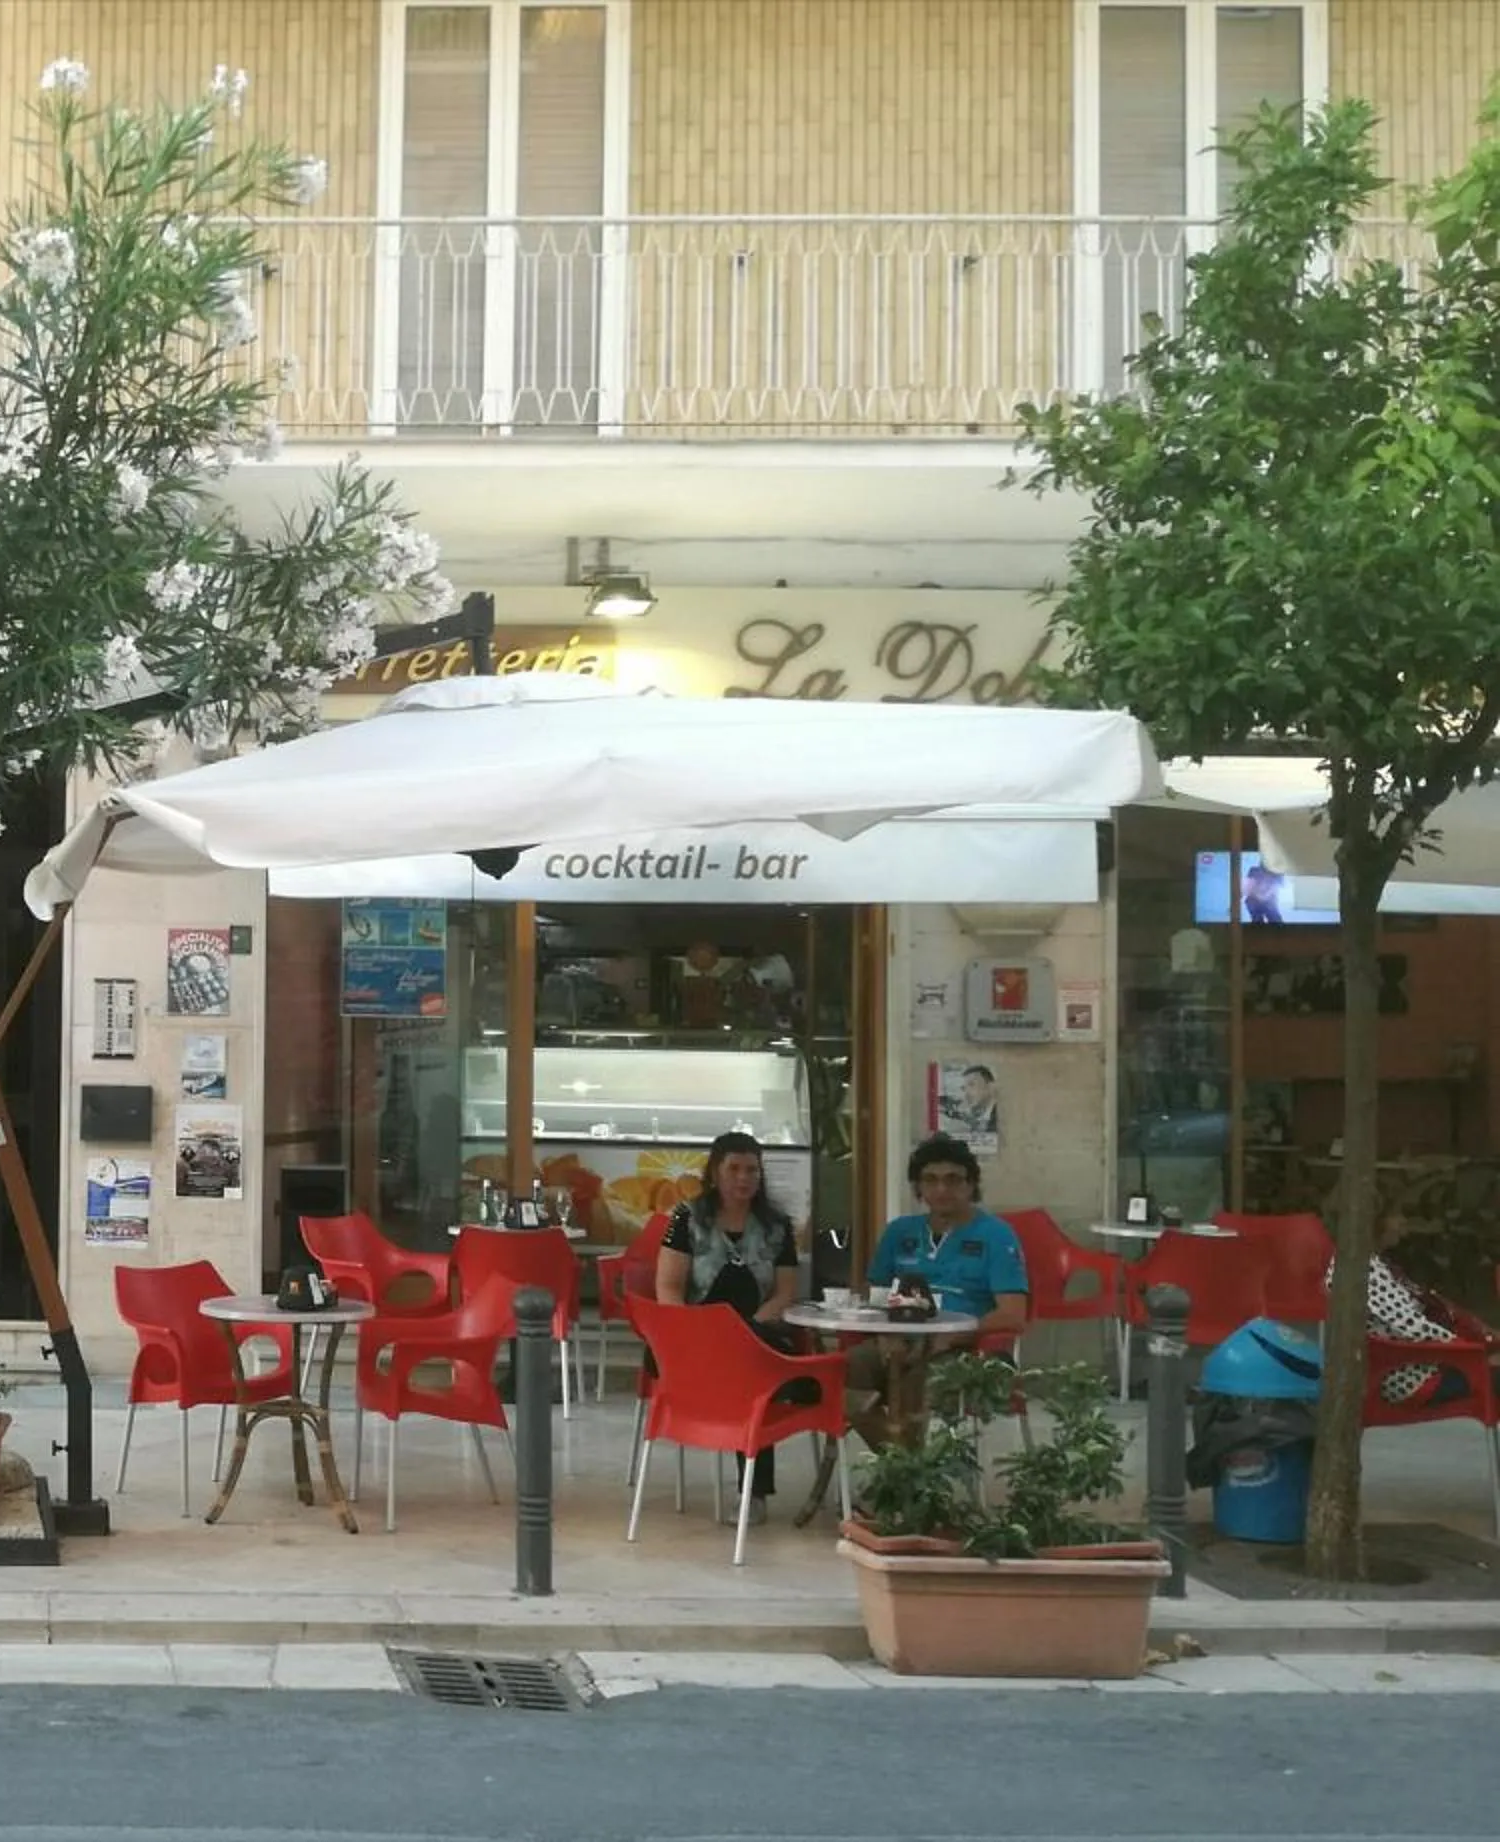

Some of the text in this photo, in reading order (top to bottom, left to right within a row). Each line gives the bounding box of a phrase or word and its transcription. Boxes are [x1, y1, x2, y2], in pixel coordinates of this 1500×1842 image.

[723, 618, 1054, 706] La Dol
[545, 844, 809, 880] cocktail- bar
